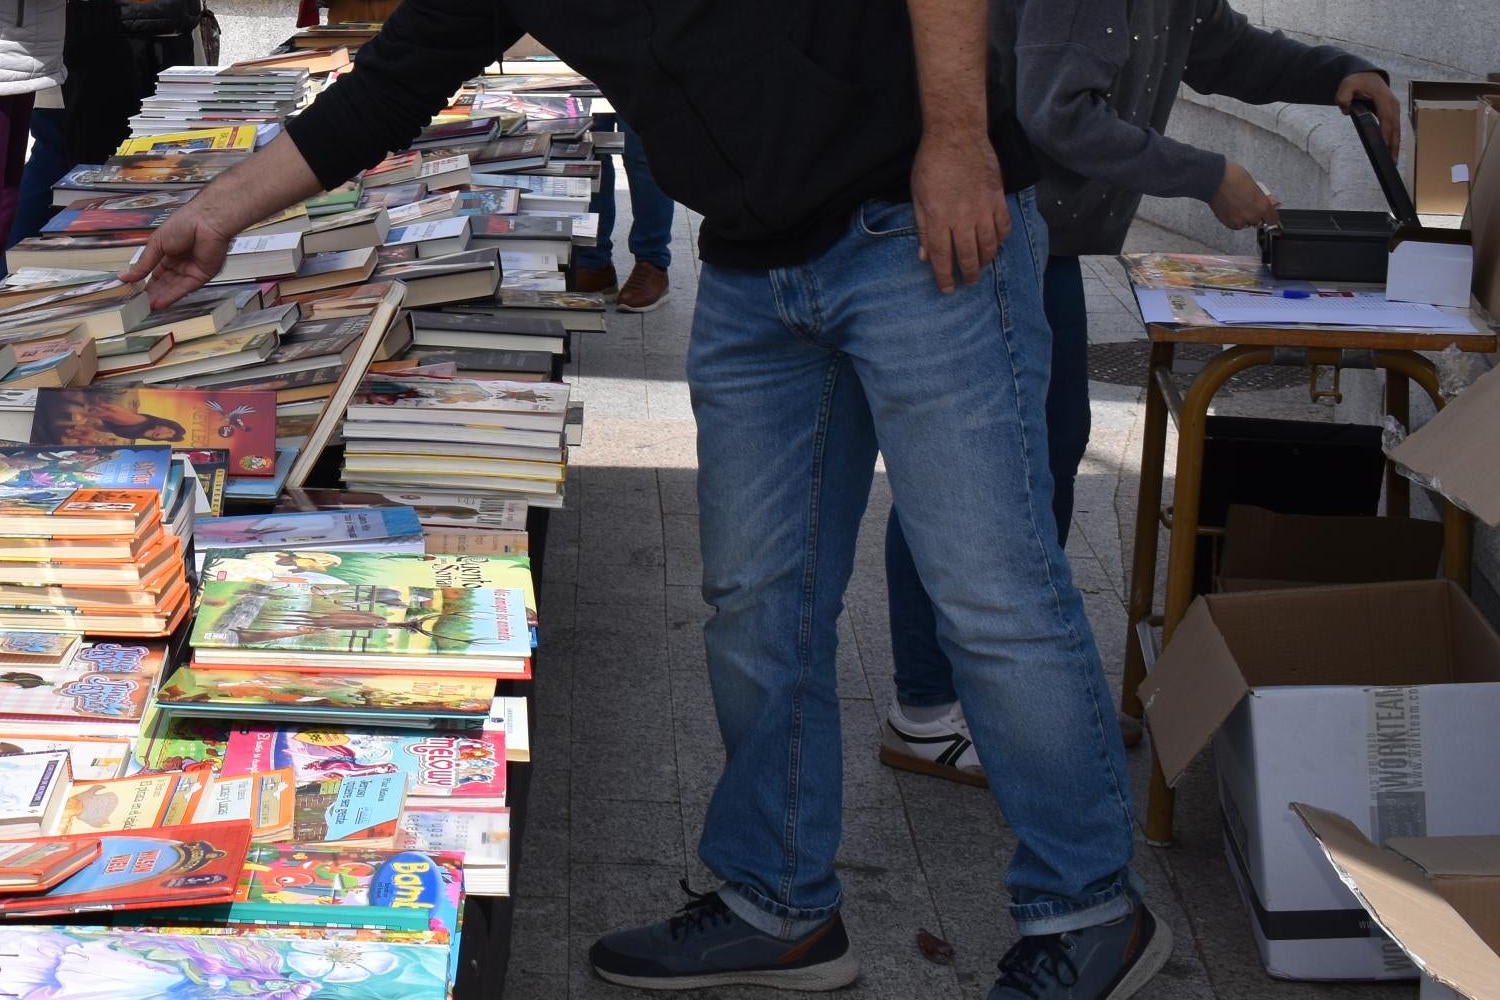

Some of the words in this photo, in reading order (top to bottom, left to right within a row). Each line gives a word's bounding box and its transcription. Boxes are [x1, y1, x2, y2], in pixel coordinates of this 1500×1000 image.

[456, 556, 492, 589] Cuento
[413, 735, 455, 786] MELOWY
[1407, 688, 1423, 788] www.workteam.co
